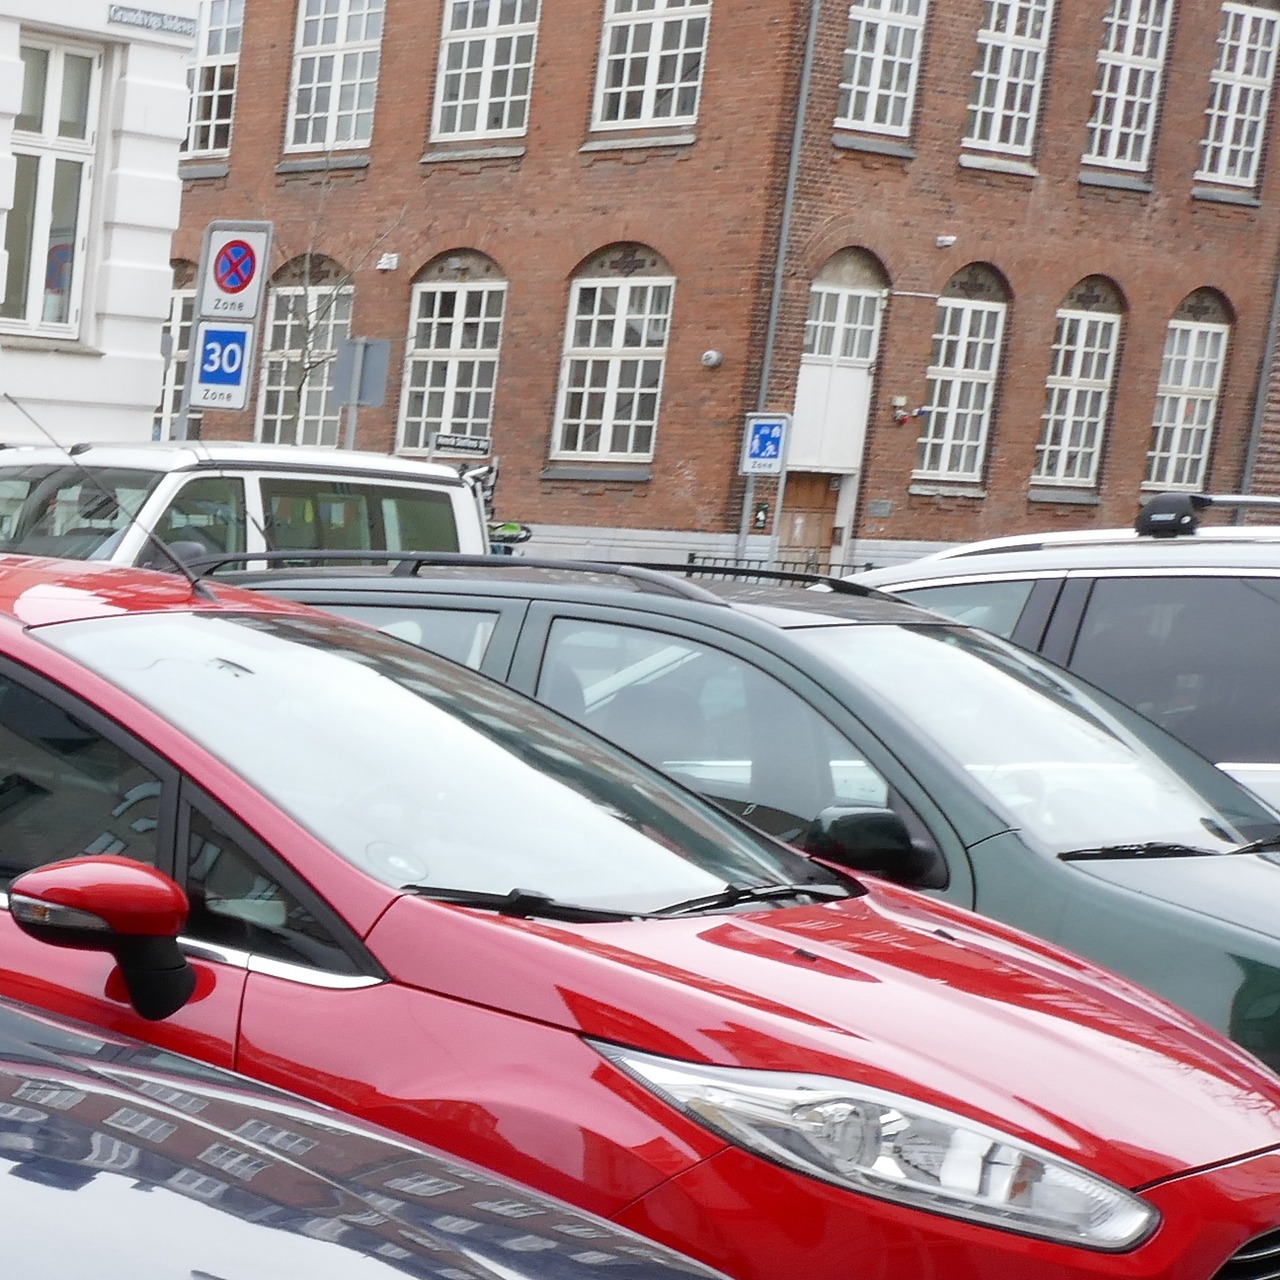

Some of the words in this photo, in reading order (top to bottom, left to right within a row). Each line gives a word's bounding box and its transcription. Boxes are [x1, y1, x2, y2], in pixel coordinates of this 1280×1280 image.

[213, 298, 244, 312] Zone
[203, 341, 242, 374] 30
[202, 388, 232, 401] Zone
[751, 460, 774, 470] Zone
